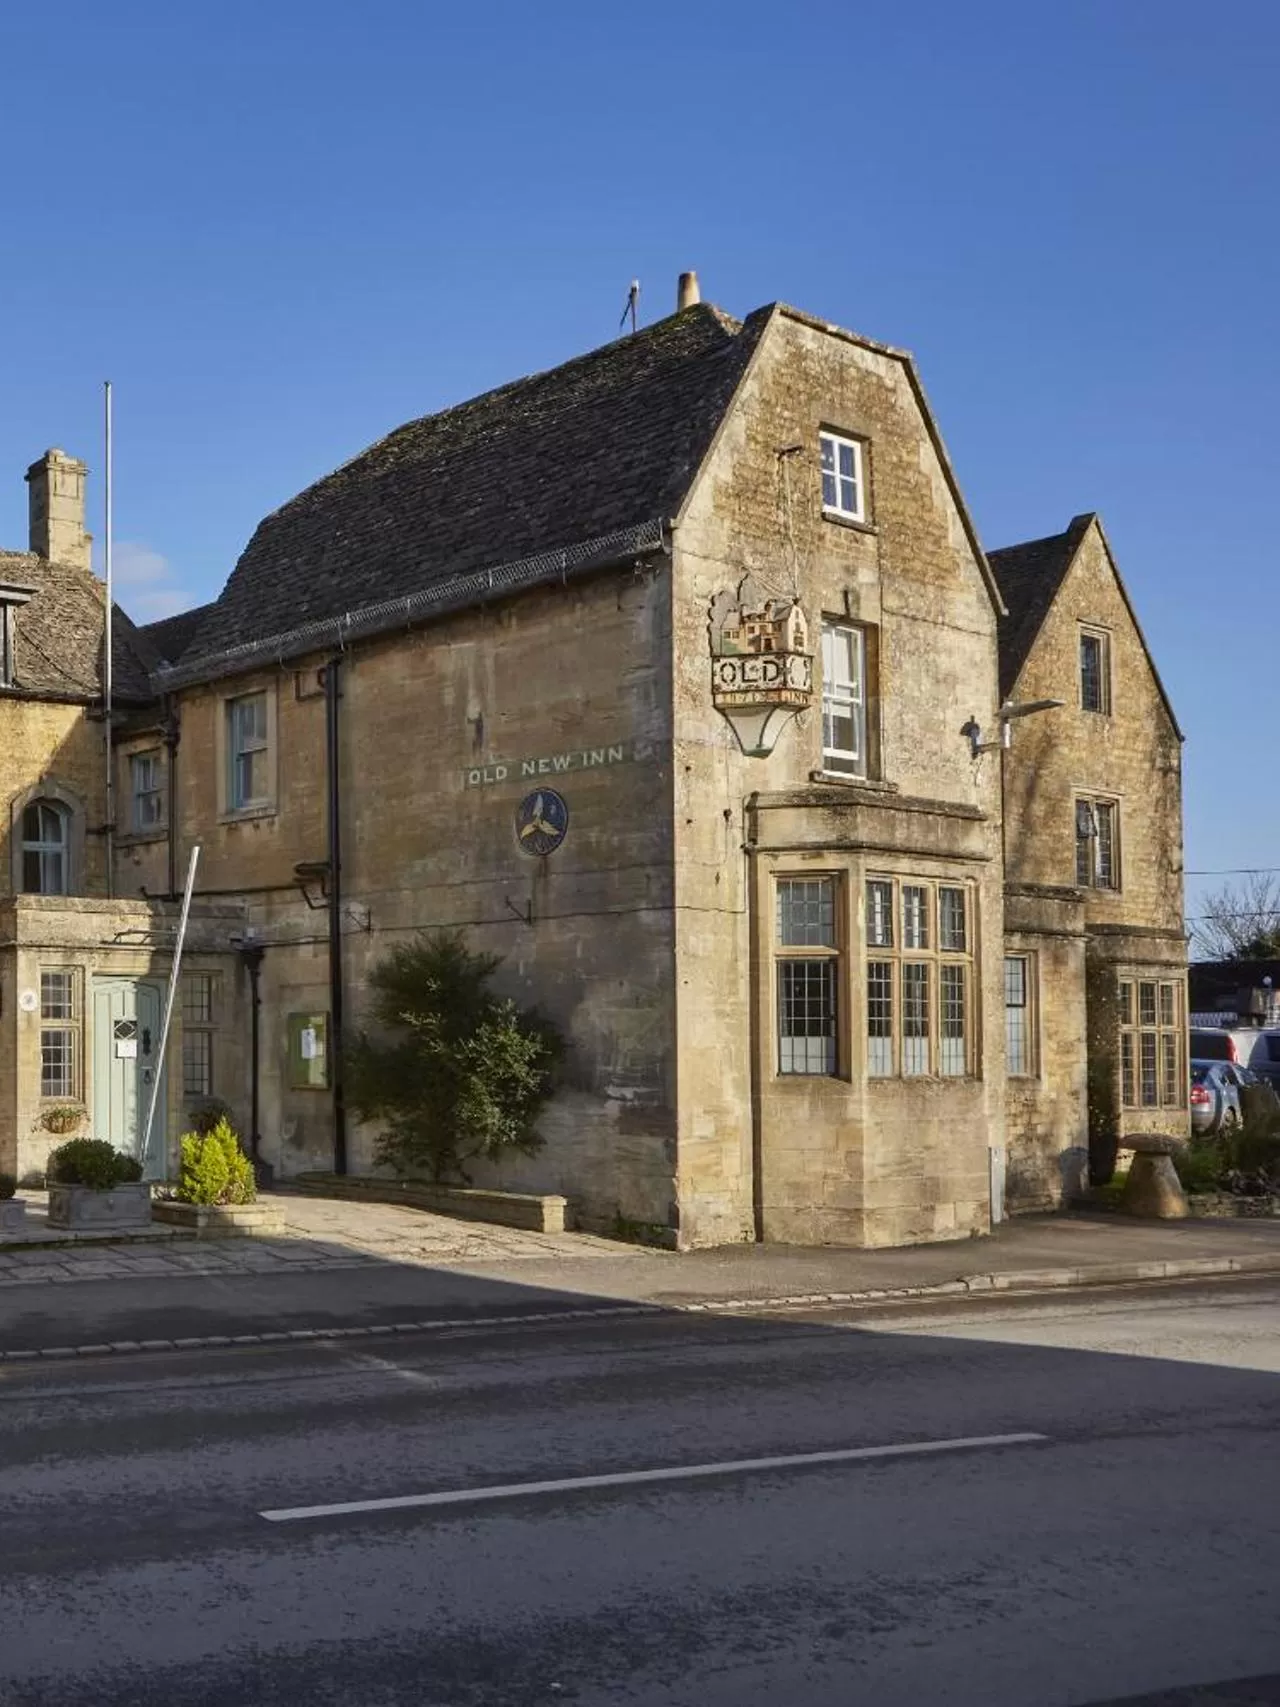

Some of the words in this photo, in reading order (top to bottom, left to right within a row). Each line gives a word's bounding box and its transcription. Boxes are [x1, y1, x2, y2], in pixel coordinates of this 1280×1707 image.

[720, 660, 780, 684] OLD
[468, 766, 508, 785] OLD
[522, 756, 570, 776] NEW
[583, 745, 623, 767] INN
